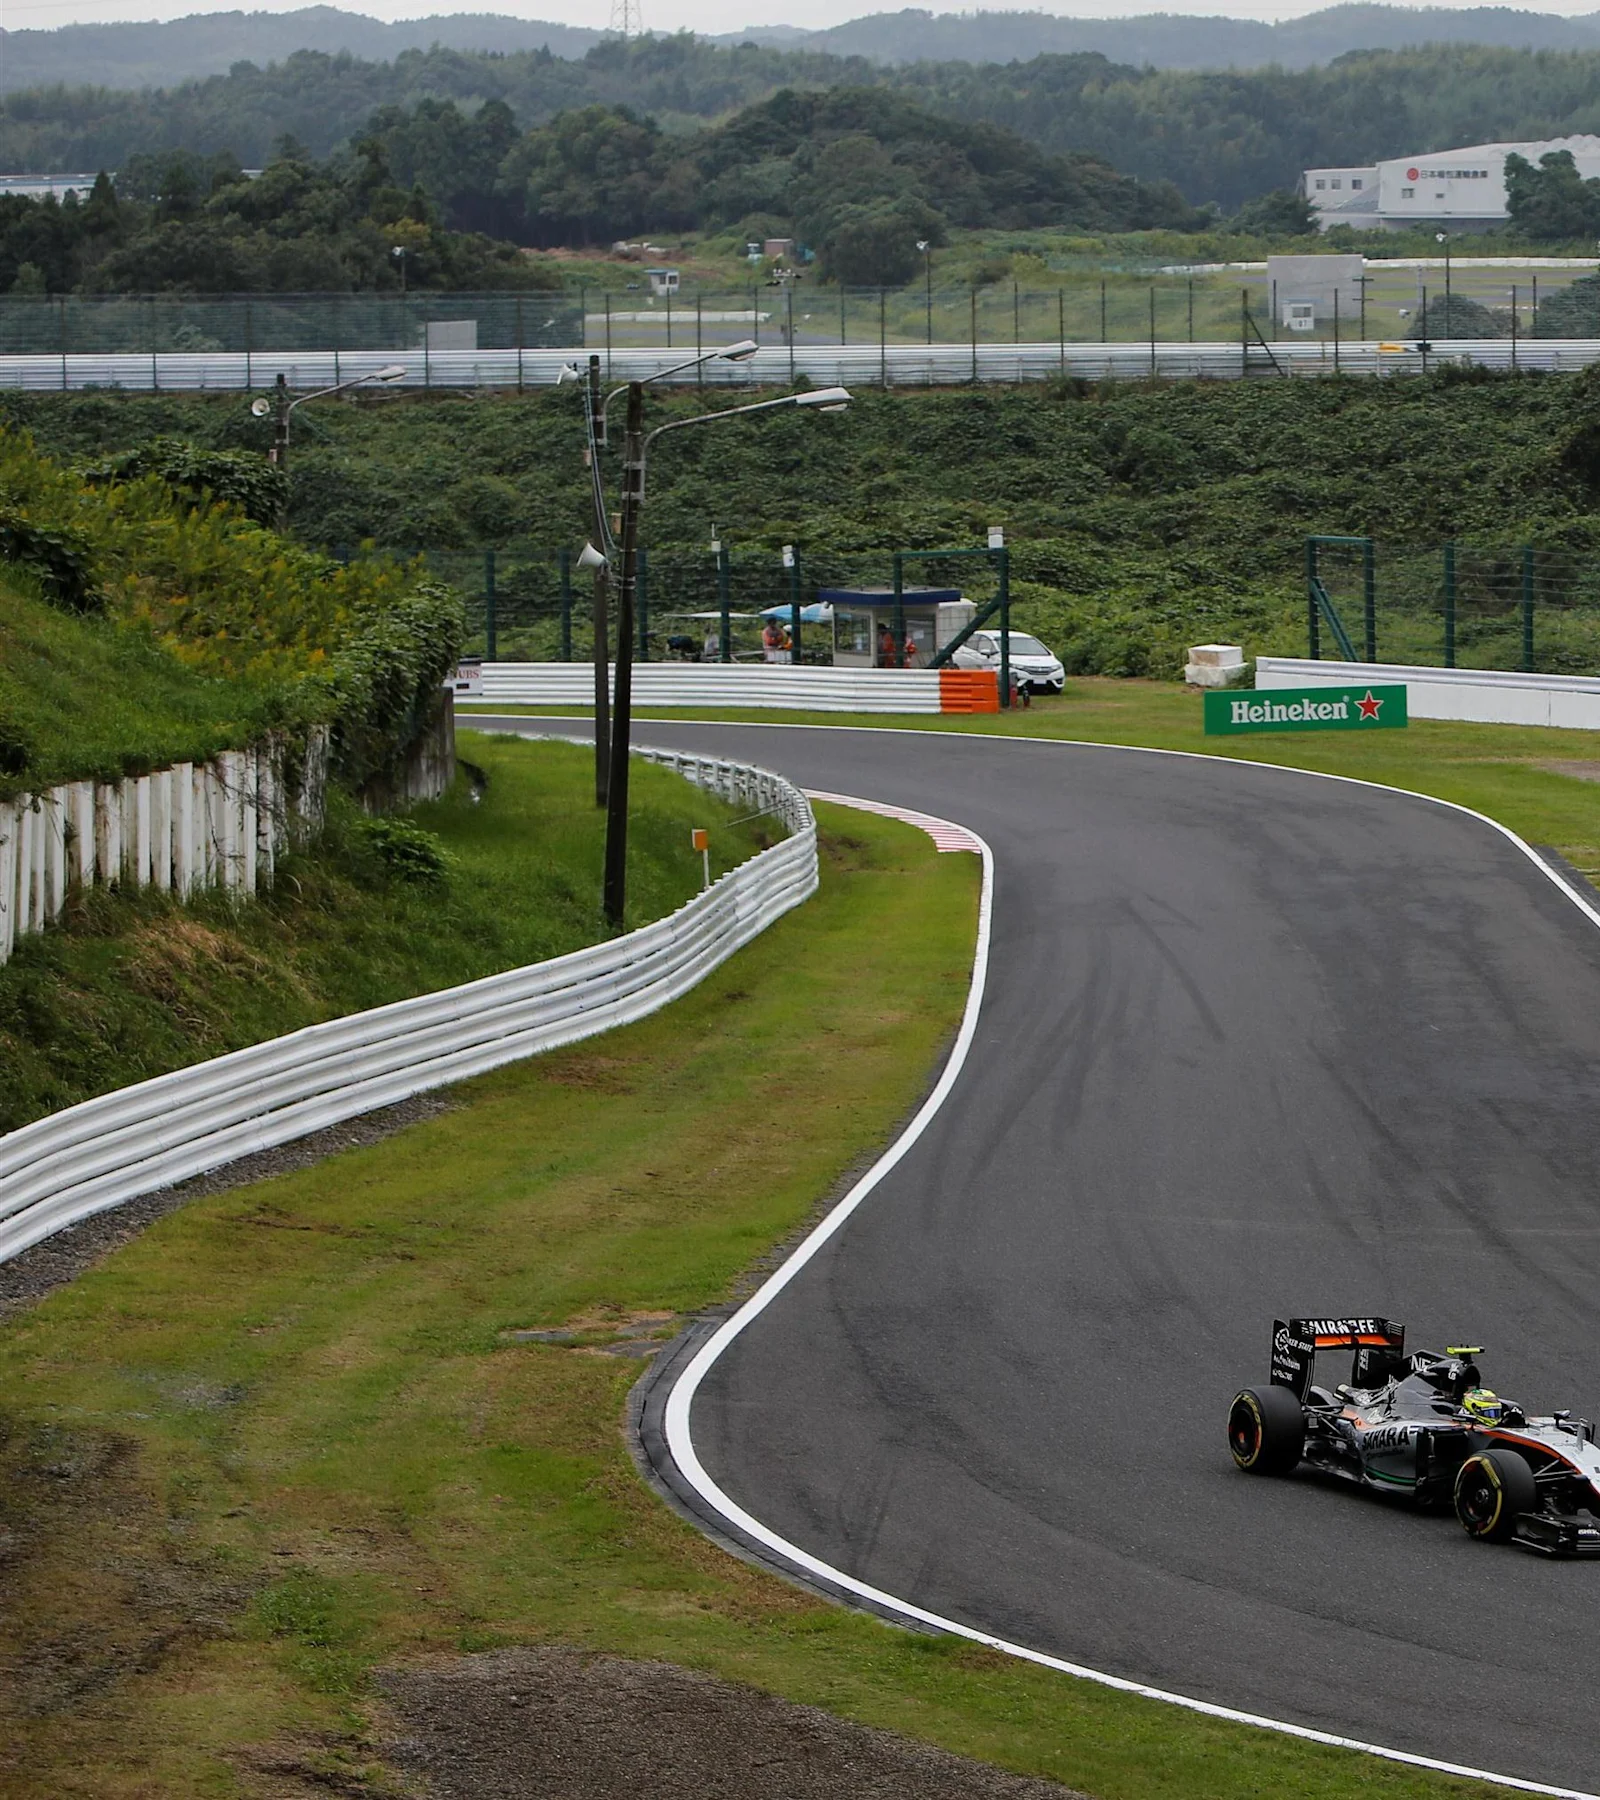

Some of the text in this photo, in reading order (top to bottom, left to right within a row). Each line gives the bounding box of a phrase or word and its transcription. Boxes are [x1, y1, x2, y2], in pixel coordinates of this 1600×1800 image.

[1230, 697, 1348, 724] Heineken
[1411, 1354, 1437, 1373] NE
[1362, 1426, 1410, 1451] SAHARA
